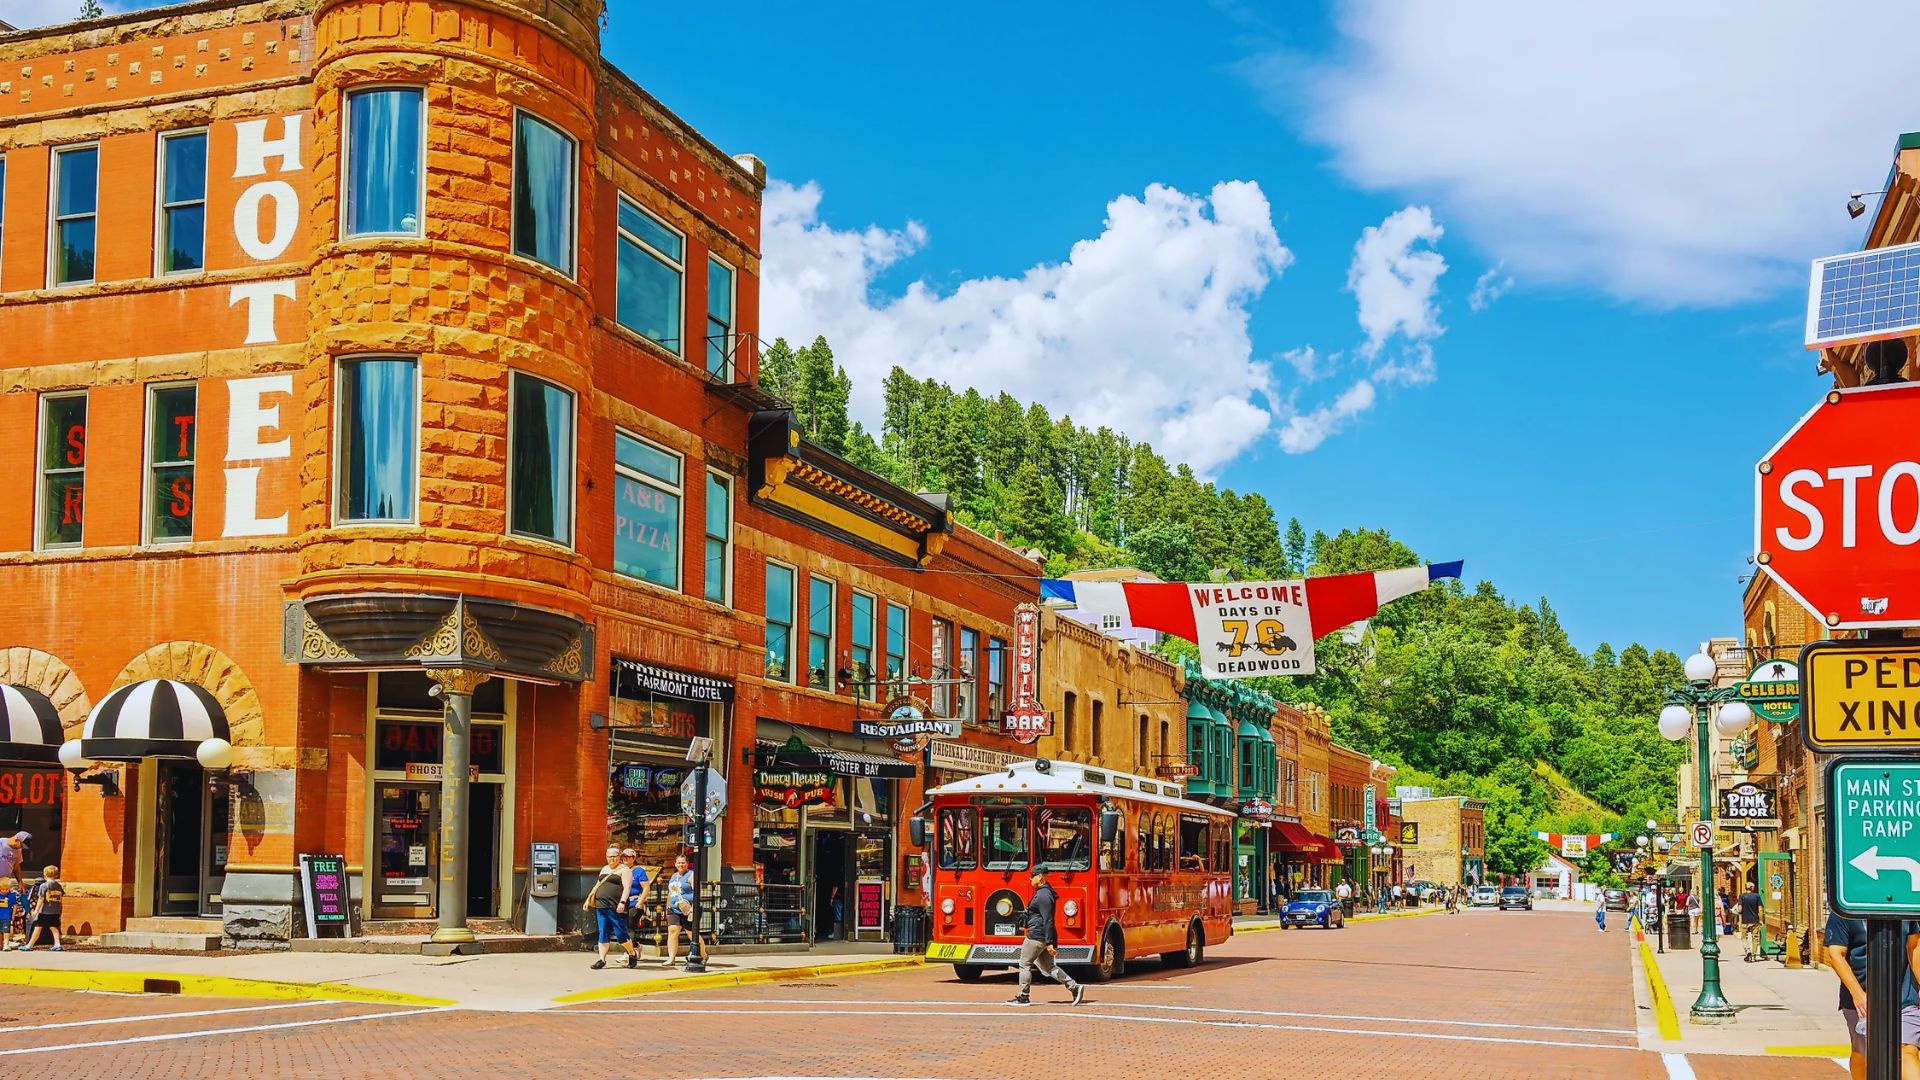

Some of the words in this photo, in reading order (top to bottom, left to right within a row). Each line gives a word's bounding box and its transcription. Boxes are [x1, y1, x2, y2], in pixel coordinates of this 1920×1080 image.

[221, 113, 304, 538] HOTEL
[623, 480, 666, 514] A&B
[1776, 461, 1920, 551] STO
[616, 514, 671, 553] PIZZA
[1194, 586, 1302, 608] WELCOME
[1218, 606, 1258, 617] DAYS
[1264, 606, 1282, 616] OF
[1020, 612, 1033, 657] WILD
[1222, 619, 1287, 657] 76
[1218, 660, 1300, 673] DEADWOOD
[1845, 657, 1920, 689] PED
[637, 673, 688, 696] FAIRMONT
[692, 686, 722, 700] HOTEL
[1020, 662, 1032, 708] BILL
[1763, 702, 1793, 711] HOTEL
[860, 721, 952, 737] RESTAURANT
[1006, 715, 1045, 730] BAR
[893, 743, 920, 752] GAMING
[932, 742, 964, 760] ORIGINAL
[965, 747, 996, 765] LOCATION
[409, 765, 442, 775] GHOST
[628, 768, 646, 778] BUD
[830, 759, 860, 774] OYSTER
[864, 764, 880, 776] BAY
[761, 789, 784, 800] IRISH
[804, 788, 824, 800] PUB
[1847, 779, 1890, 797] MAIN
[1727, 793, 1768, 809] PINK
[1730, 808, 1768, 817] DOOR
[1862, 820, 1913, 838] RAMP
[314, 862, 337, 872] FREE
[316, 882, 339, 890] SHRIMP
[966, 890, 972, 900] 5
[938, 945, 957, 958] KOA
